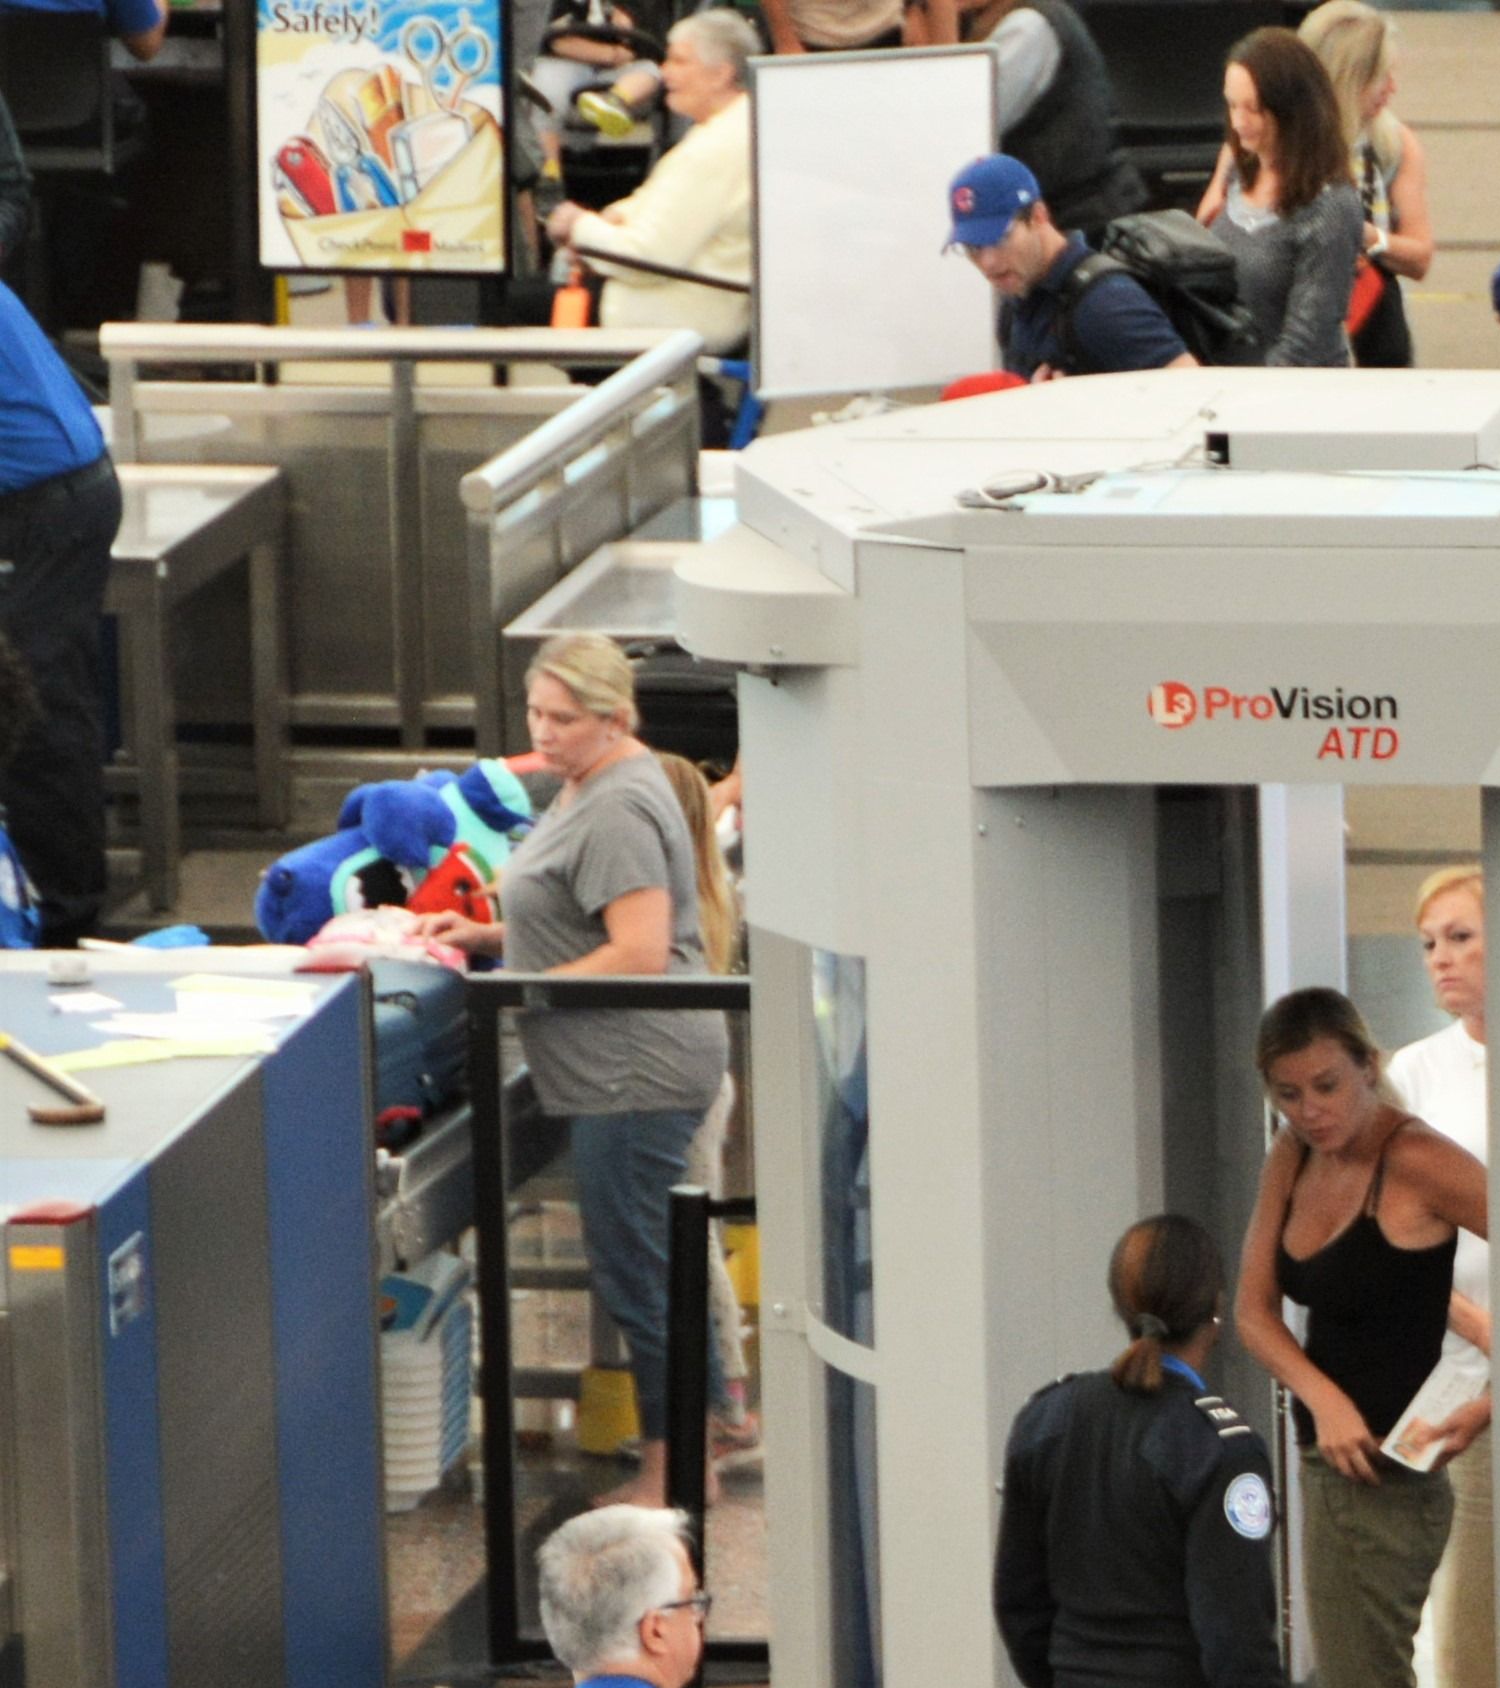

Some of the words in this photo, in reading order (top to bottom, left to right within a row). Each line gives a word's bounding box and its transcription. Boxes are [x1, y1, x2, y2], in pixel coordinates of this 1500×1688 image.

[273, 2, 380, 44] Safely!
[1203, 686, 1399, 721] ProVision
[1317, 726, 1399, 760] ATD
